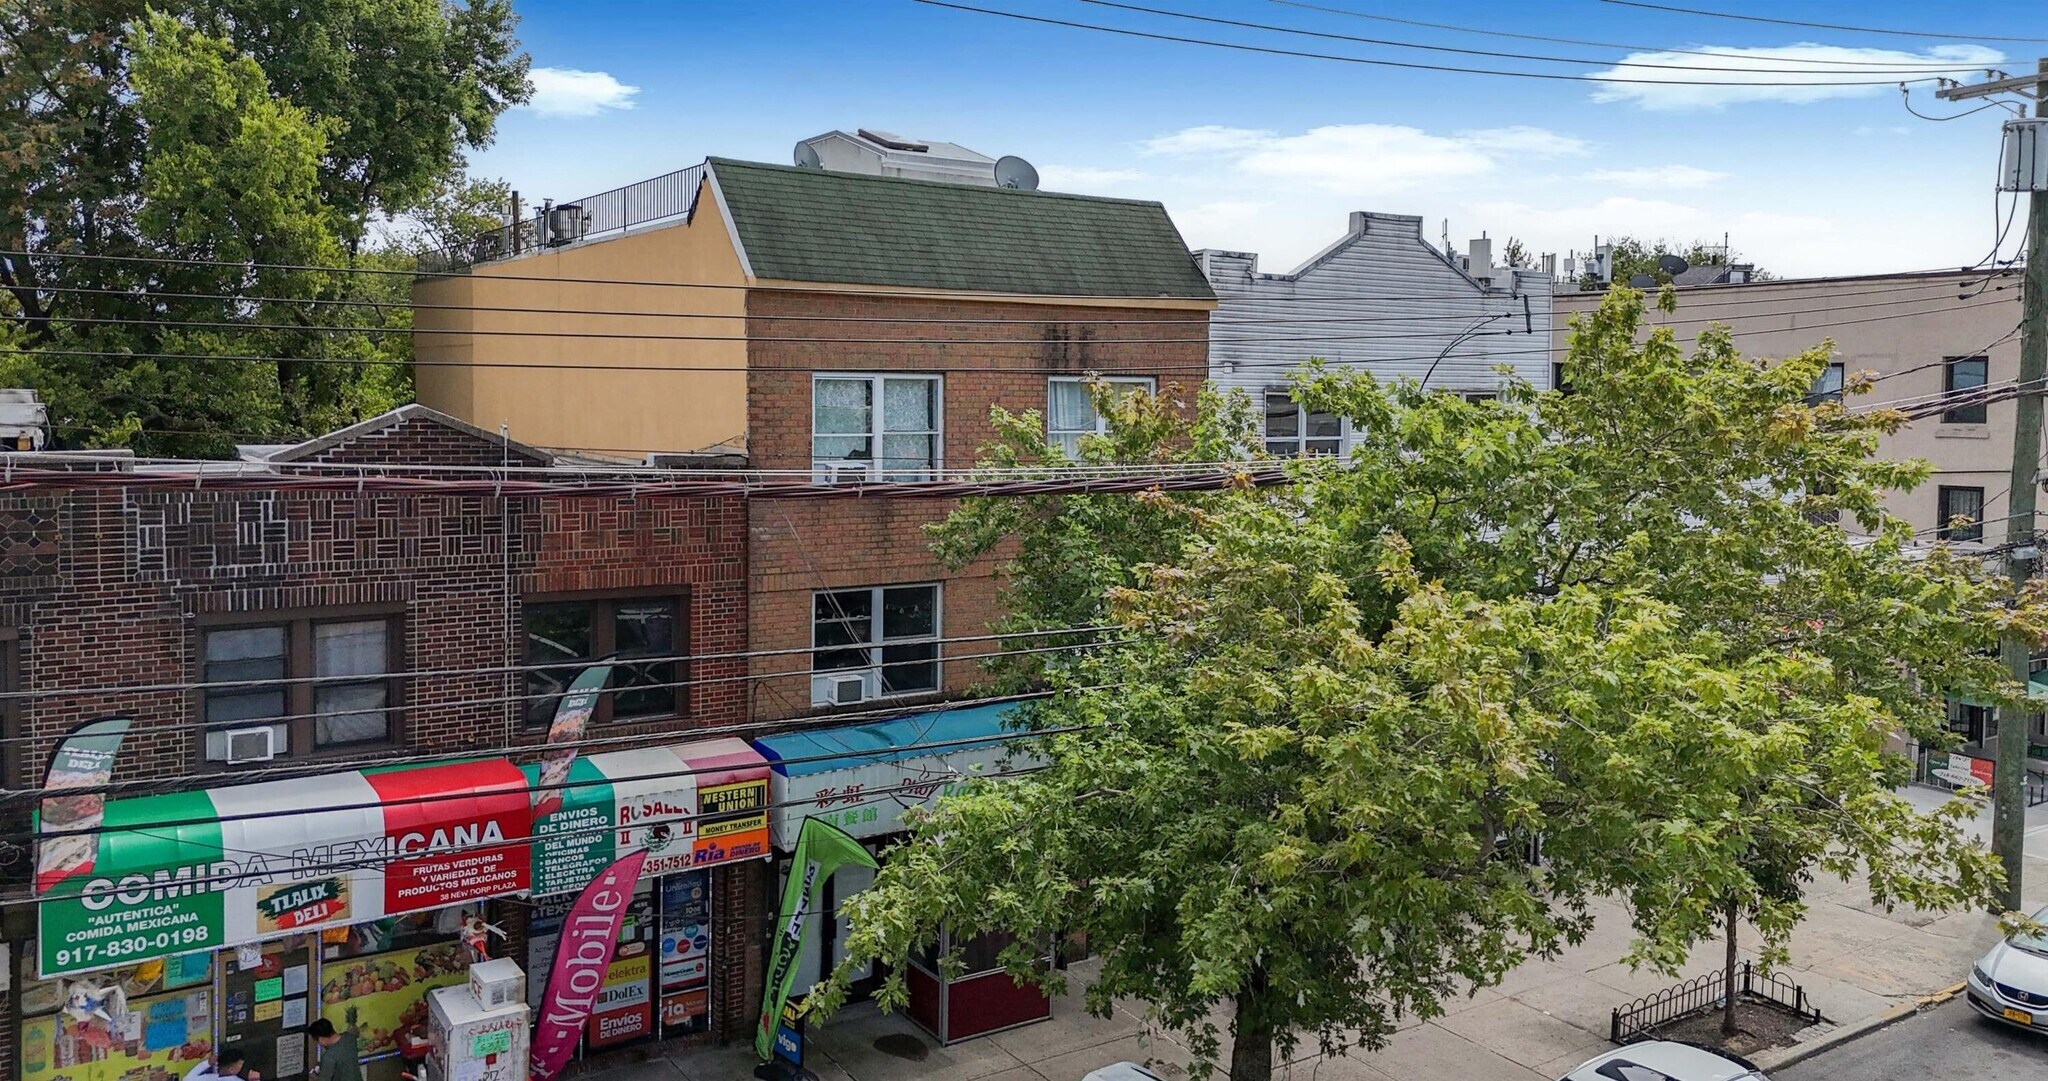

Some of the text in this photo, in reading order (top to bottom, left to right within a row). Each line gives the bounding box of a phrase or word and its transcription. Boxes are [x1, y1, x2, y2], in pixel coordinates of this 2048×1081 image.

[703, 787, 755, 804] WESTERN
[718, 798, 755, 812] UNION
[550, 807, 598, 822] ENVIOS
[540, 823, 558, 834] DE
[560, 816, 608, 831] DINERO
[706, 818, 762, 834] MONEY TRANSFER
[544, 834, 603, 851] DEL MUNDO
[545, 846, 590, 857] OFICINAS
[545, 854, 585, 866] BANCOS
[694, 842, 725, 864] Ria
[80, 819, 505, 911] COMIDA MEXICANA
[412, 854, 504, 876] FRUTAS VERDURAS
[421, 864, 497, 883] Y VARIEDAD DE
[545, 857, 608, 873] TELEGRAFOS
[545, 866, 596, 880] ELECKTRA
[398, 870, 517, 899] PRODUCTOS MEXICANOS
[545, 874, 592, 887] TARJETAS
[270, 883, 329, 914] TLALIX
[440, 882, 517, 902] 38 NEW DORP PLAZA
[293, 902, 328, 926] DELI
[66, 912, 199, 943] COMIDA MEXICANA
[56, 926, 209, 966] 917-830-0198
[547, 890, 622, 1030] Mobile
[608, 964, 646, 980] elektra
[609, 986, 644, 1002] DolEx
[600, 1012, 643, 1031] Envíos
[600, 1023, 643, 1039] DE DINERO
[778, 1033, 797, 1053] vigo
